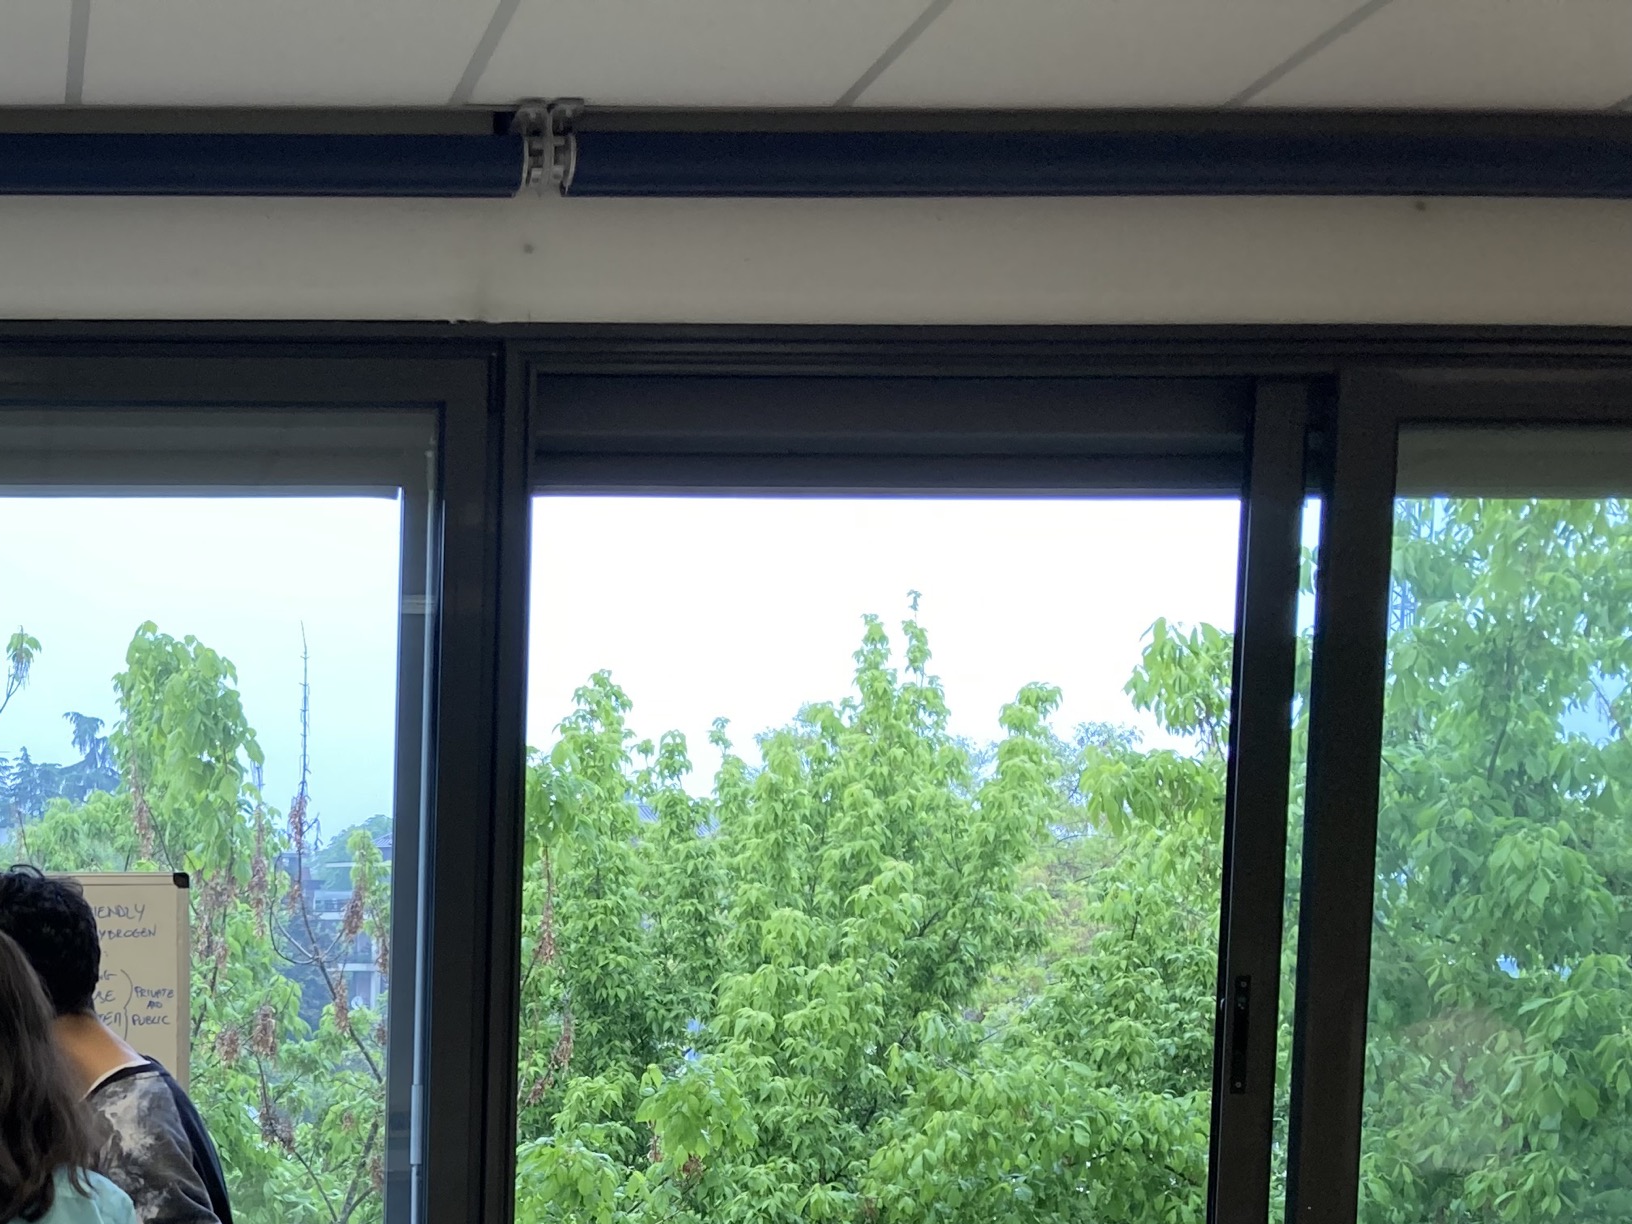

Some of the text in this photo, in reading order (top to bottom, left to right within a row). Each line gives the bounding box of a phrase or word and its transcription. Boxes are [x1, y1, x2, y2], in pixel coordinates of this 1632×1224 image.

[93, 904, 145, 921] IENDLY
[99, 924, 156, 940] YDROGEN
[131, 1014, 171, 1026] PUBLIC
